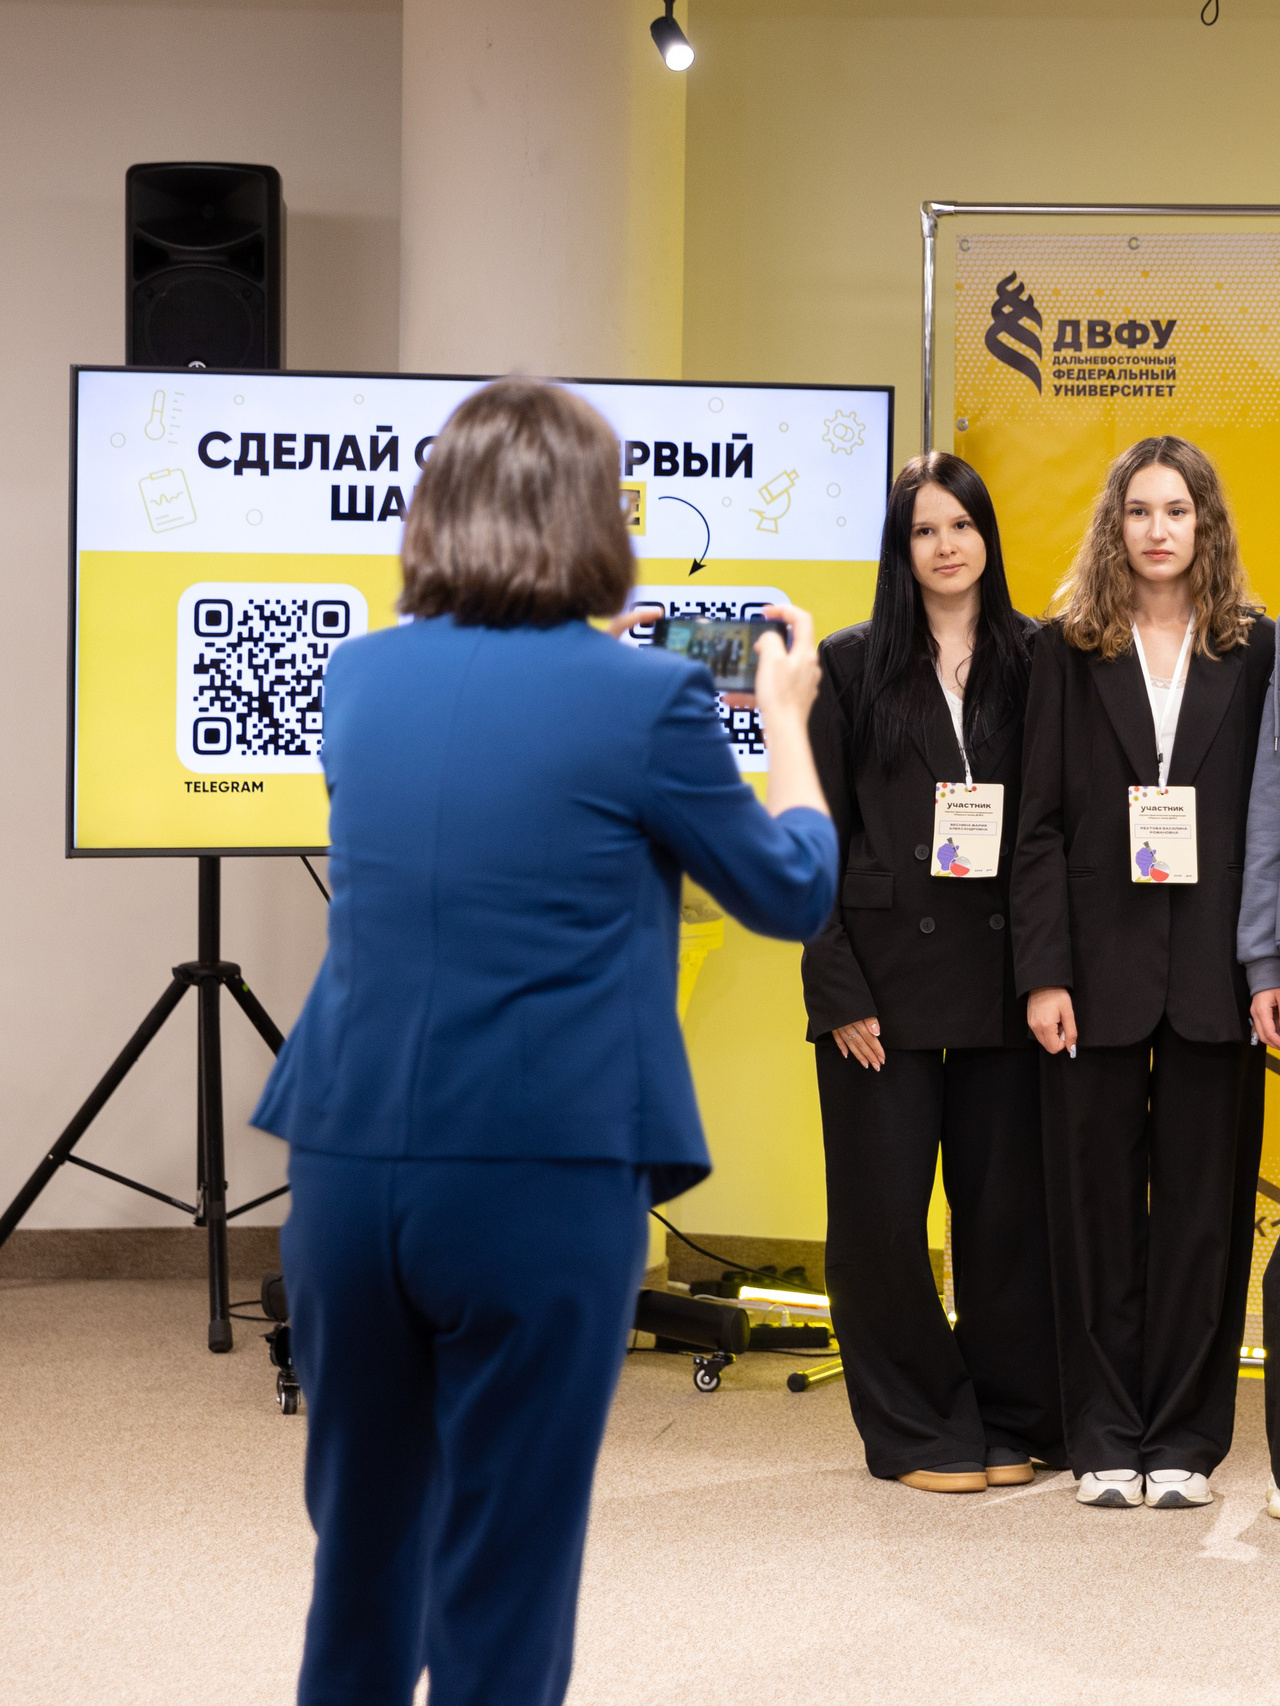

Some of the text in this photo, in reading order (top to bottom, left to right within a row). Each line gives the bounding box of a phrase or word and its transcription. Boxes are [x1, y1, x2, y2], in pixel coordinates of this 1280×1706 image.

[1053, 319, 1177, 353] ДВФУ
[1052, 354, 1177, 366] ДАЛЬНЕВОСТОЧНЫЙ
[1052, 367, 1177, 381] ФЕДЕРАЛЬНЫЙ
[1053, 384, 1176, 397] УНИВЕРСИТЕТ
[198, 425, 399, 476] СДЕЛАЙ
[617, 432, 753, 479] РВЫЙ
[331, 484, 418, 522] ША
[185, 781, 264, 793] TELEGRAM
[1140, 805, 1184, 813] участник
